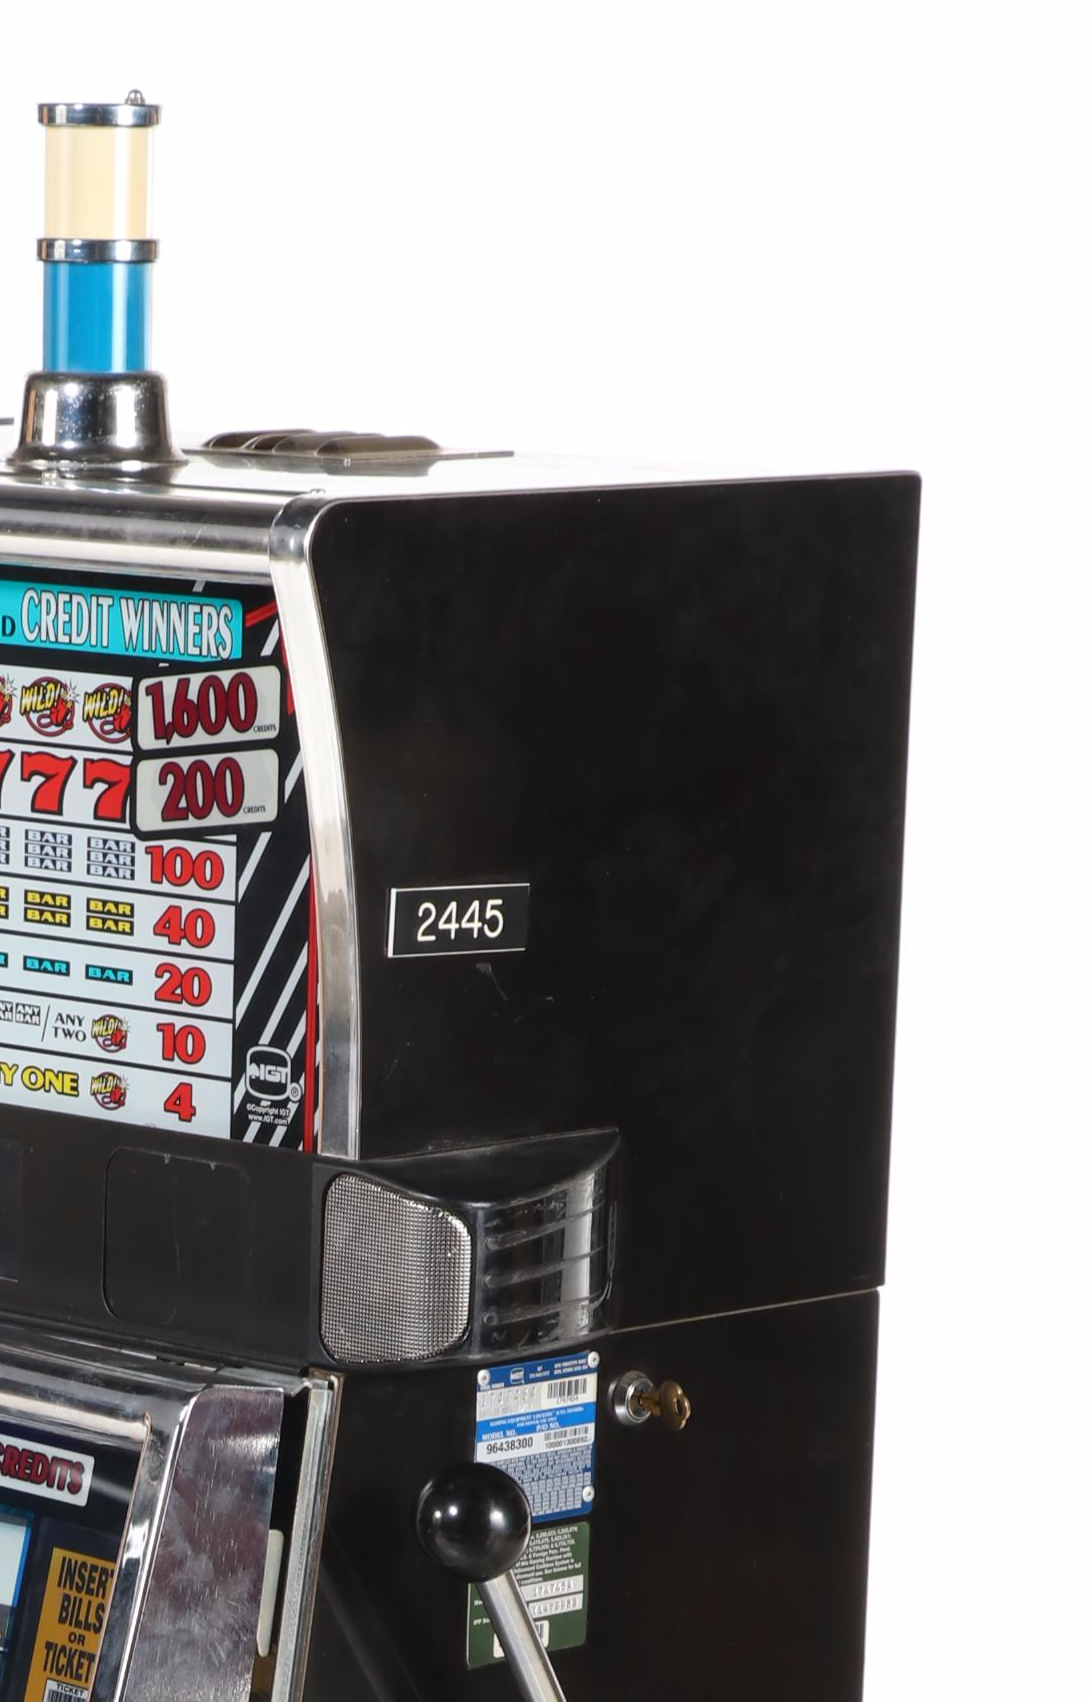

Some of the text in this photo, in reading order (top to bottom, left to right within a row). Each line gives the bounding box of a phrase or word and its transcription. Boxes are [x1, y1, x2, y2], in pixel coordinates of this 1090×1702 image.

[21, 589, 114, 647] CREDIT
[120, 598, 233, 660] WINNERS
[20, 681, 60, 714] WILD!
[83, 688, 123, 721] WILD!
[145, 671, 258, 745] 1,600
[253, 724, 276, 734] CREDITS
[21, 751, 77, 815] 7
[83, 758, 131, 823] 7
[158, 757, 245, 822] 200
[243, 805, 266, 814] CREDITS
[145, 845, 224, 891] 100
[26, 891, 69, 908] BAR
[89, 899, 132, 916] BAR
[153, 905, 215, 949] 40
[26, 908, 69, 926] BAR
[89, 916, 132, 934] BAR
[417, 899, 504, 942] 2445
[25, 957, 68, 975] BAR
[88, 966, 131, 983] BAR
[154, 962, 212, 1006] 20
[52, 1026, 87, 1042] TWO
[55, 1012, 206, 1064] ANY WILD! 10
[21, 1065, 79, 1097] ONE
[90, 1074, 118, 1096] WILD!
[164, 1082, 196, 1122] 4
[260, 1064, 288, 1084] IGT
[248, 1114, 288, 1125] www.IGT.com
[486, 1437, 533, 1455] 96438300
[57, 1557, 114, 1599] INSER
[58, 1594, 105, 1634] BILLS
[68, 1632, 85, 1646] OR
[56, 1683, 84, 1697] TICKET
